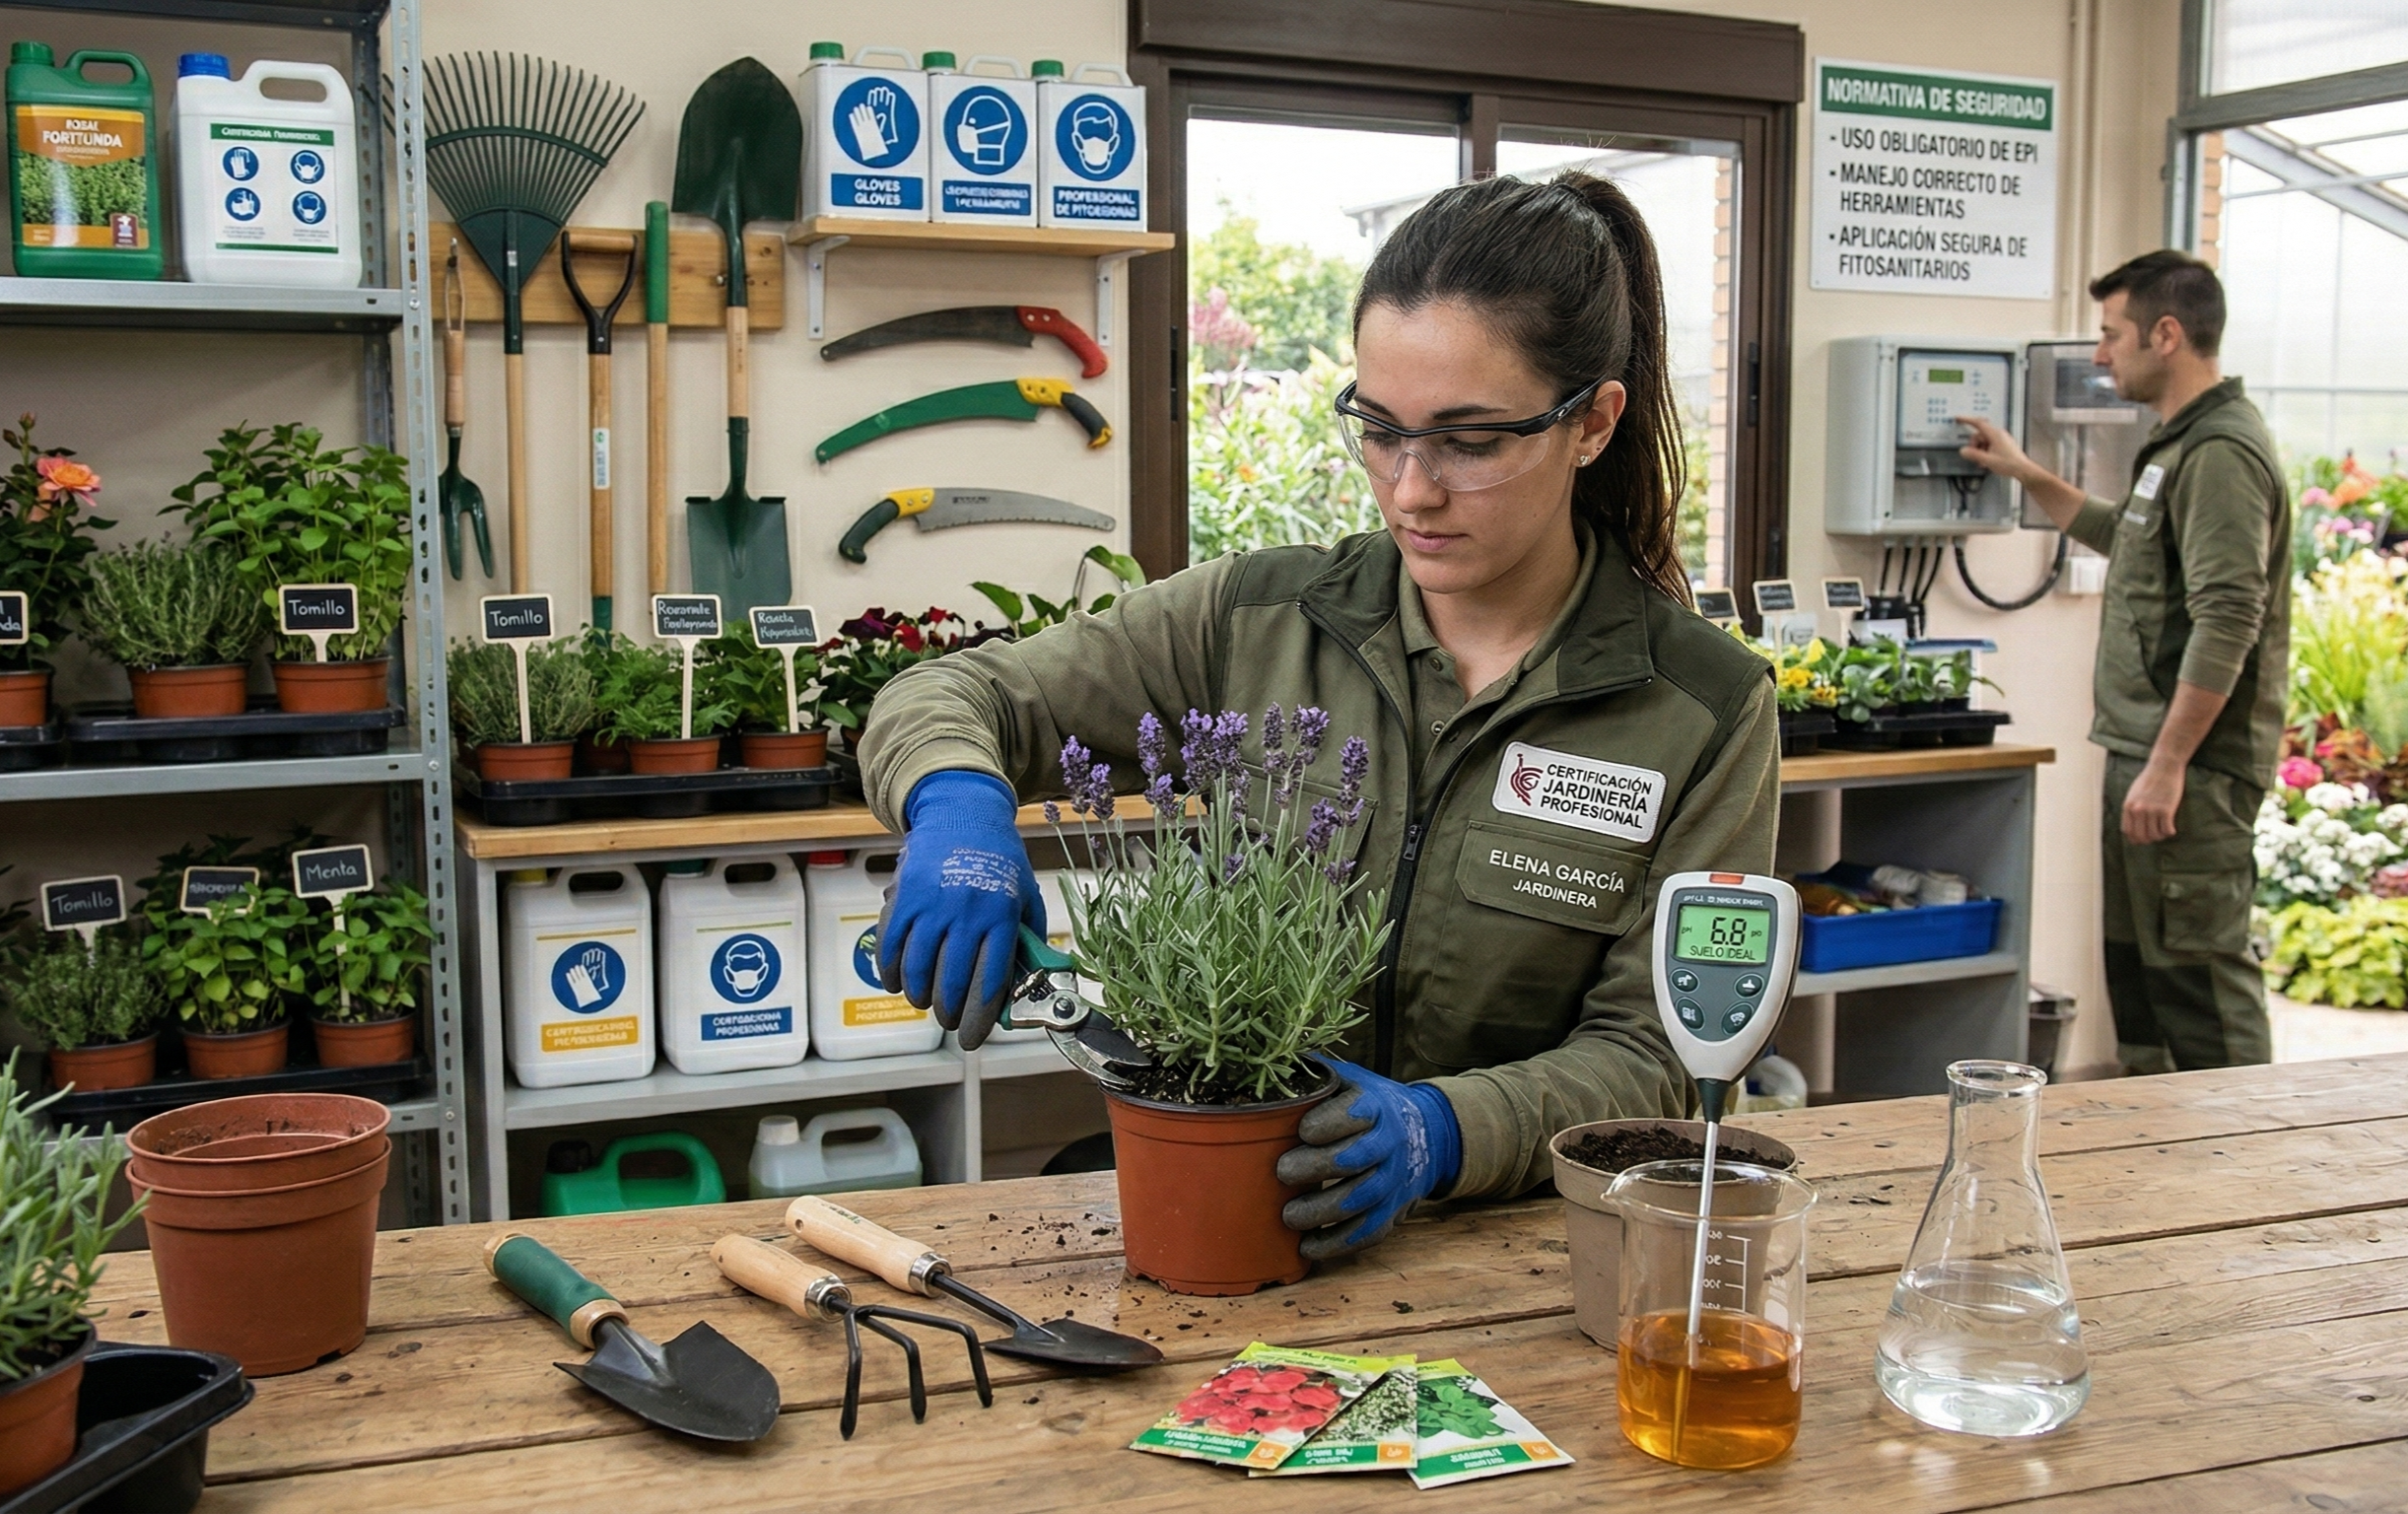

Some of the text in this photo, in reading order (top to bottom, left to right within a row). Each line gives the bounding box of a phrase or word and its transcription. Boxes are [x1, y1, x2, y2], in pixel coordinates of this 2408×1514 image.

[1827, 77, 2046, 121] NORMATIVA DE SEGURIDAD
[1842, 127, 2037, 163] USO OBLIGATORIO DE EPI
[855, 178, 901, 193] GLOVES
[1841, 162, 2021, 196] MANEJO CORRECTO DE
[855, 191, 902, 206] GLOVES
[1841, 190, 1965, 219] HERRAMIENTAS
[1839, 225, 2028, 257] APLICACIÓN SEGURA DE
[1839, 253, 1970, 281] FITOSANITARIOS
[288, 599, 345, 615] Tomillo
[489, 609, 543, 627] Tomillo
[1547, 764, 1652, 794] CERTIFICACIÓN
[1543, 779, 1647, 813] JARDINERÍA
[1541, 795, 1643, 829] PROFESIONAL
[306, 860, 358, 882] Menta
[1489, 850, 1624, 893] ELENA GARCÍA
[51, 890, 113, 915] Tomillo
[1513, 879, 1597, 908] JARDINERA
[1710, 917, 1747, 946] 6.8
[1689, 945, 1724, 958] SUELO
